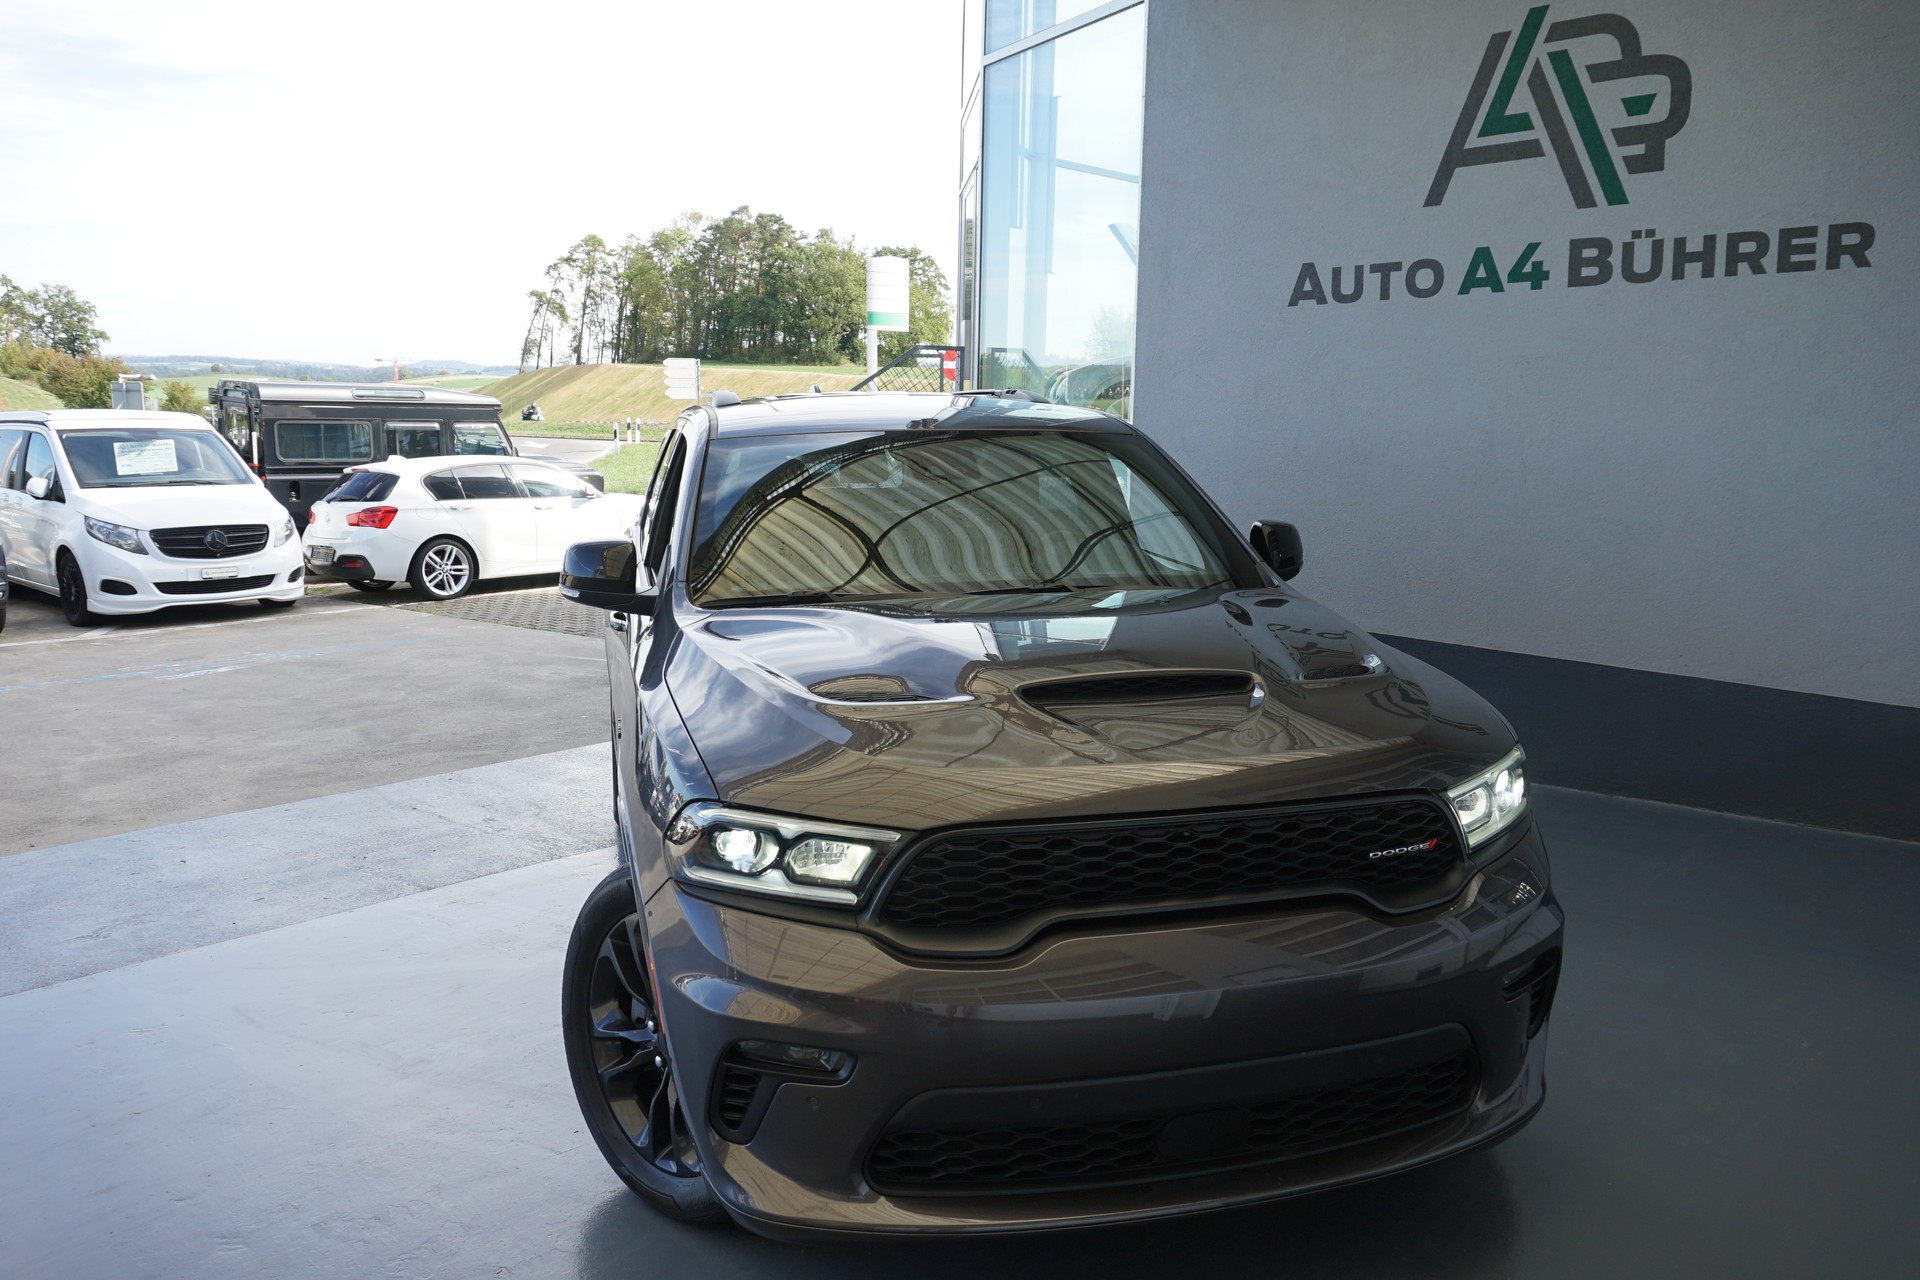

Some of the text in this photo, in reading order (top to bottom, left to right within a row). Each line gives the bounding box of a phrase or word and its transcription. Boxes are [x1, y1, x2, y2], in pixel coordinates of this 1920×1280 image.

[1288, 222, 1876, 307] AUTO A4 BÜHRER
[1369, 841, 1431, 859] DODGE
